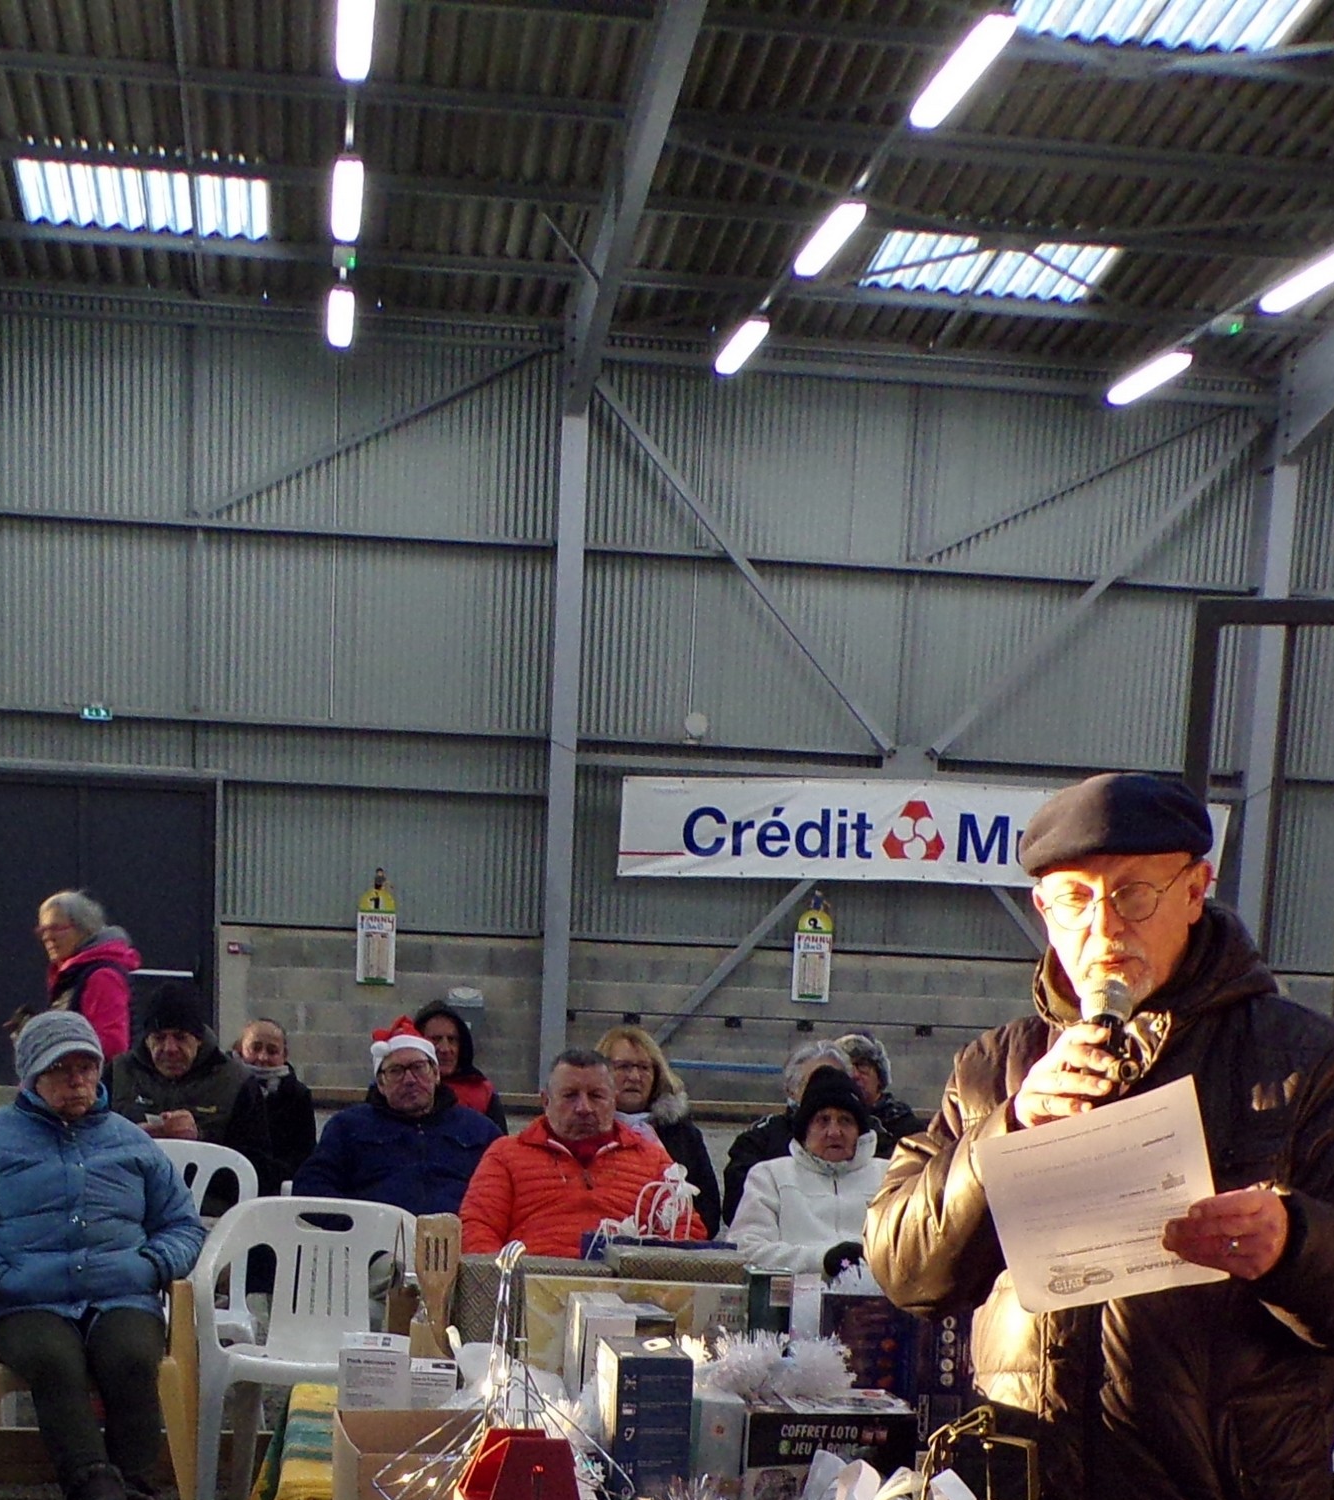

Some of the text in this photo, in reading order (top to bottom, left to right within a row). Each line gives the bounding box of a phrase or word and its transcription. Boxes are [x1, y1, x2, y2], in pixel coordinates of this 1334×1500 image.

[683, 806, 1024, 867] Crédit M
[370, 895, 381, 910] 1
[360, 914, 395, 932] FANNY
[797, 934, 832, 952] FANNY
[780, 1424, 859, 1440] COFFRET LOTO
[791, 1440, 813, 1456] JEU
